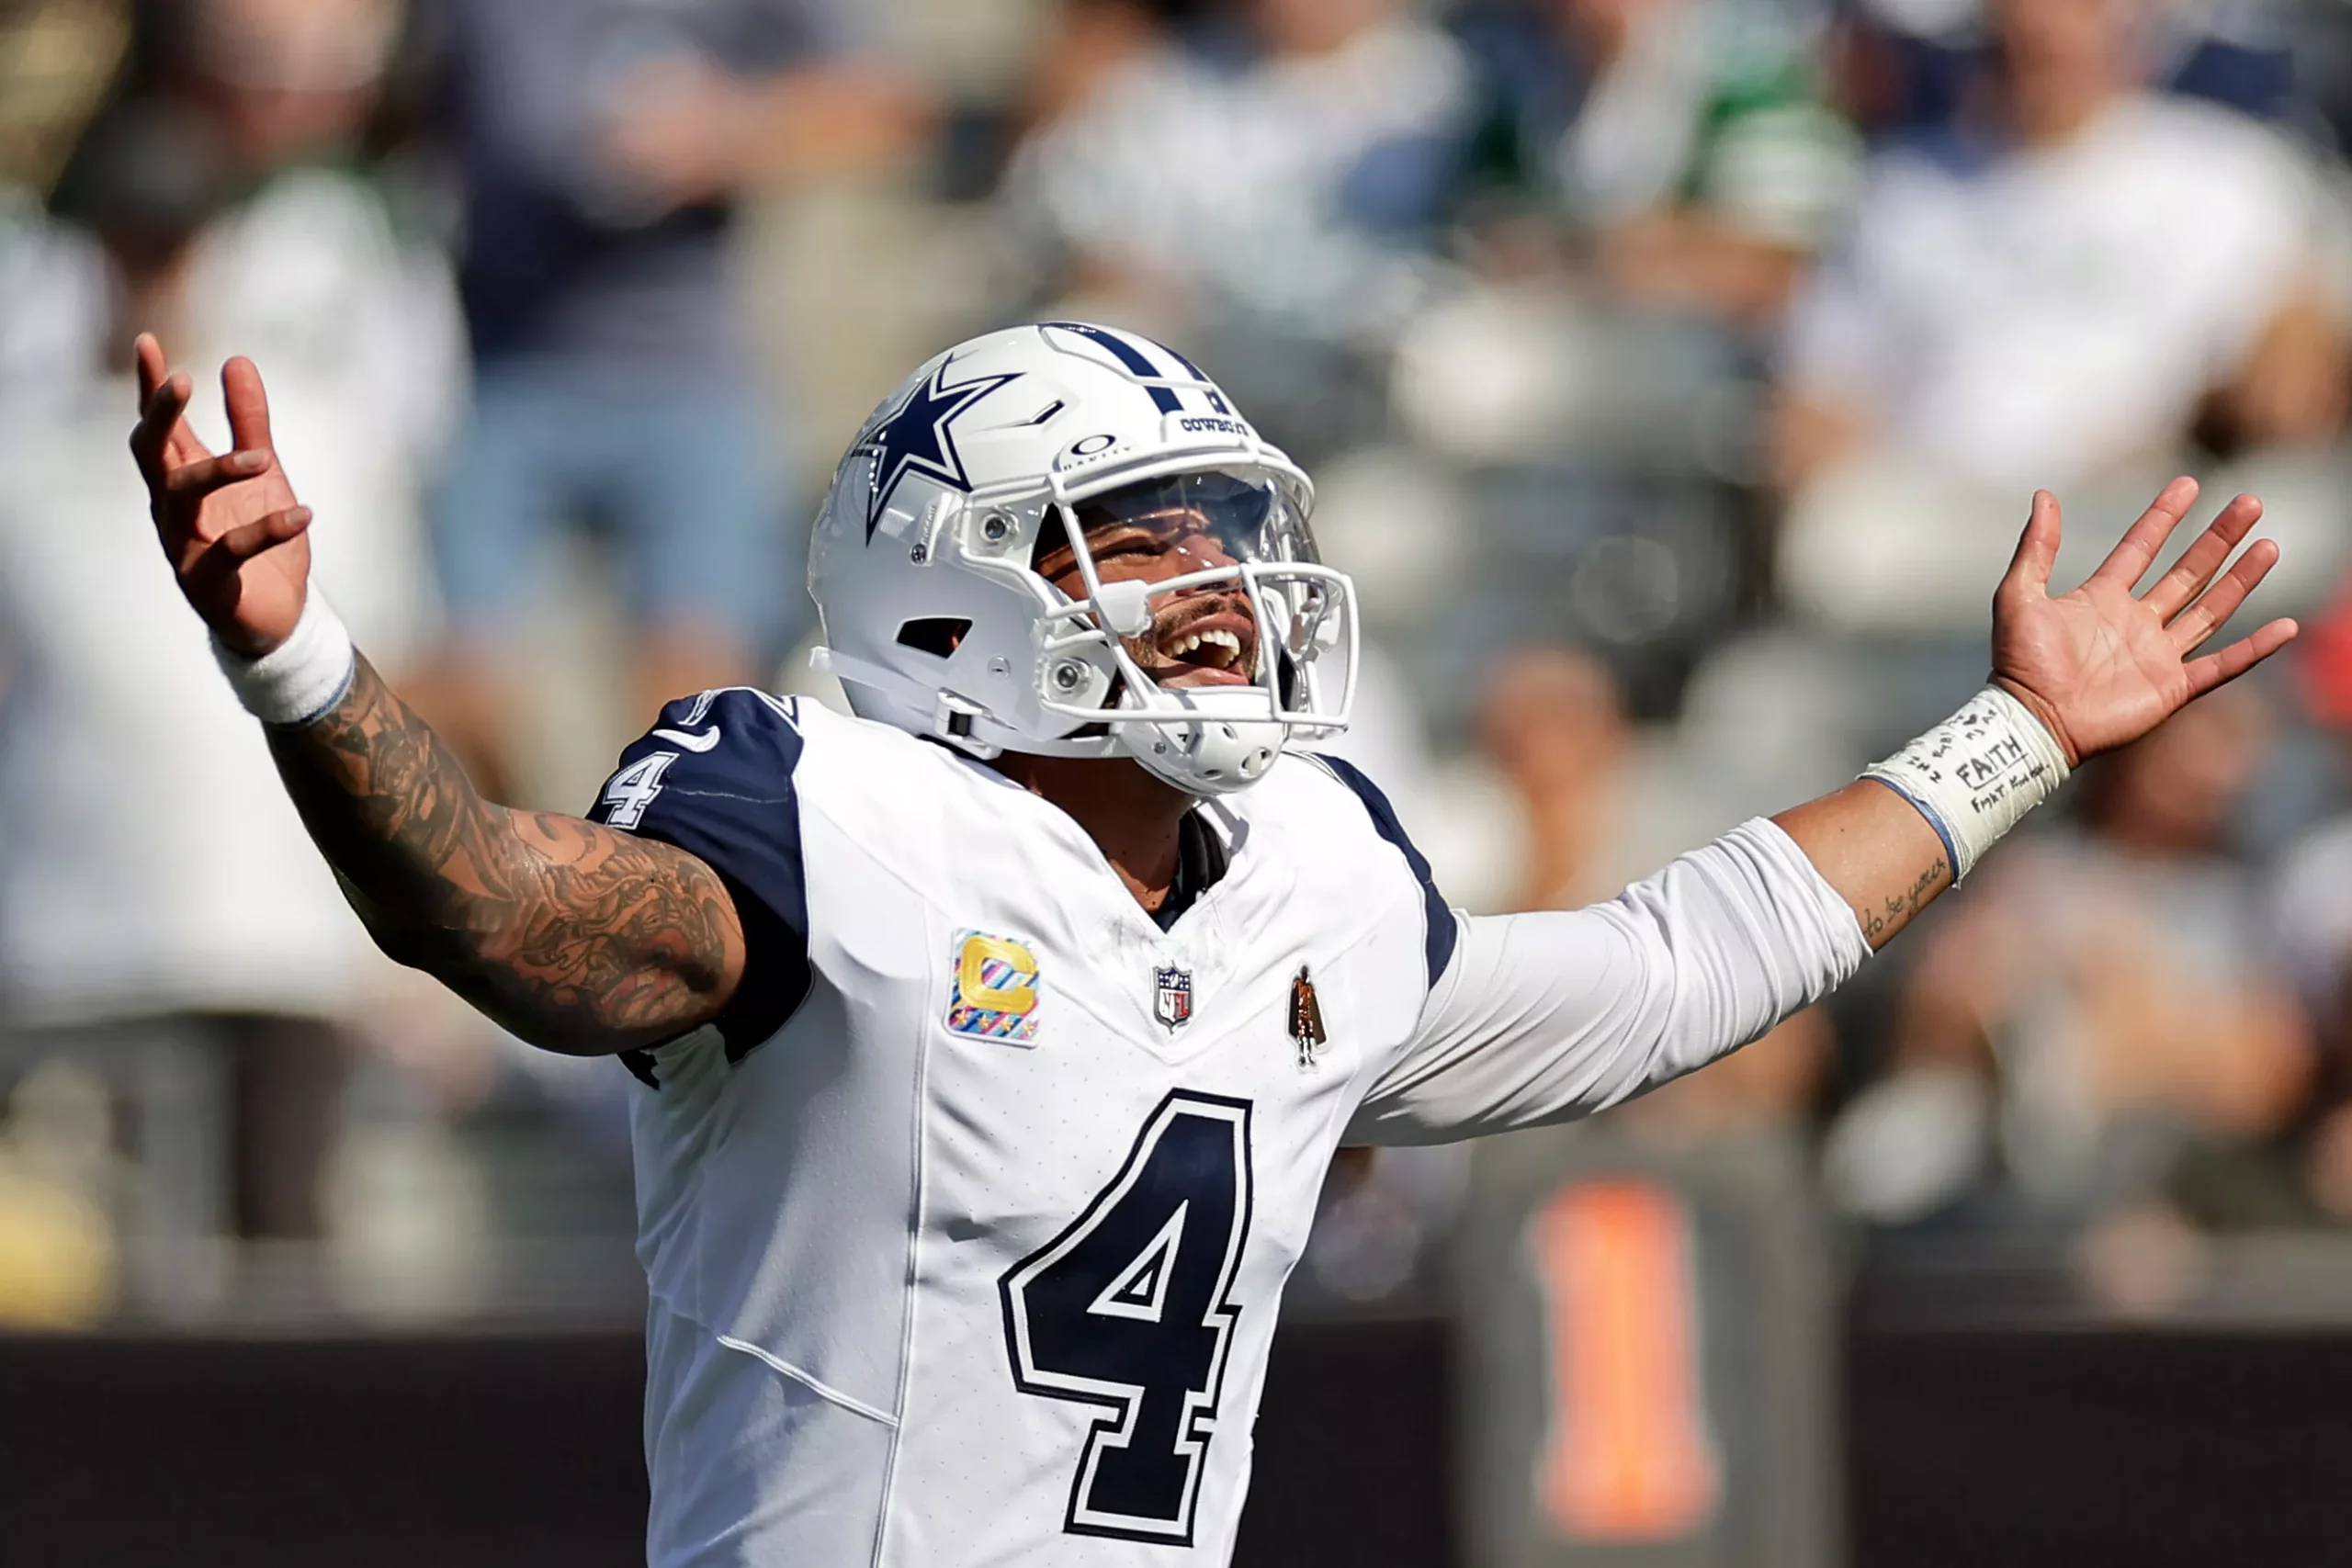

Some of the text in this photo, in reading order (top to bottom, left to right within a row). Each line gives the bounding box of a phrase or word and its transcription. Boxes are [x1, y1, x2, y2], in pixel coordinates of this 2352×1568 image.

[602, 750, 680, 829] 4
[1955, 734, 2022, 789] FAITH
[958, 934, 1037, 1014] C
[997, 1087, 1253, 1548] 4
